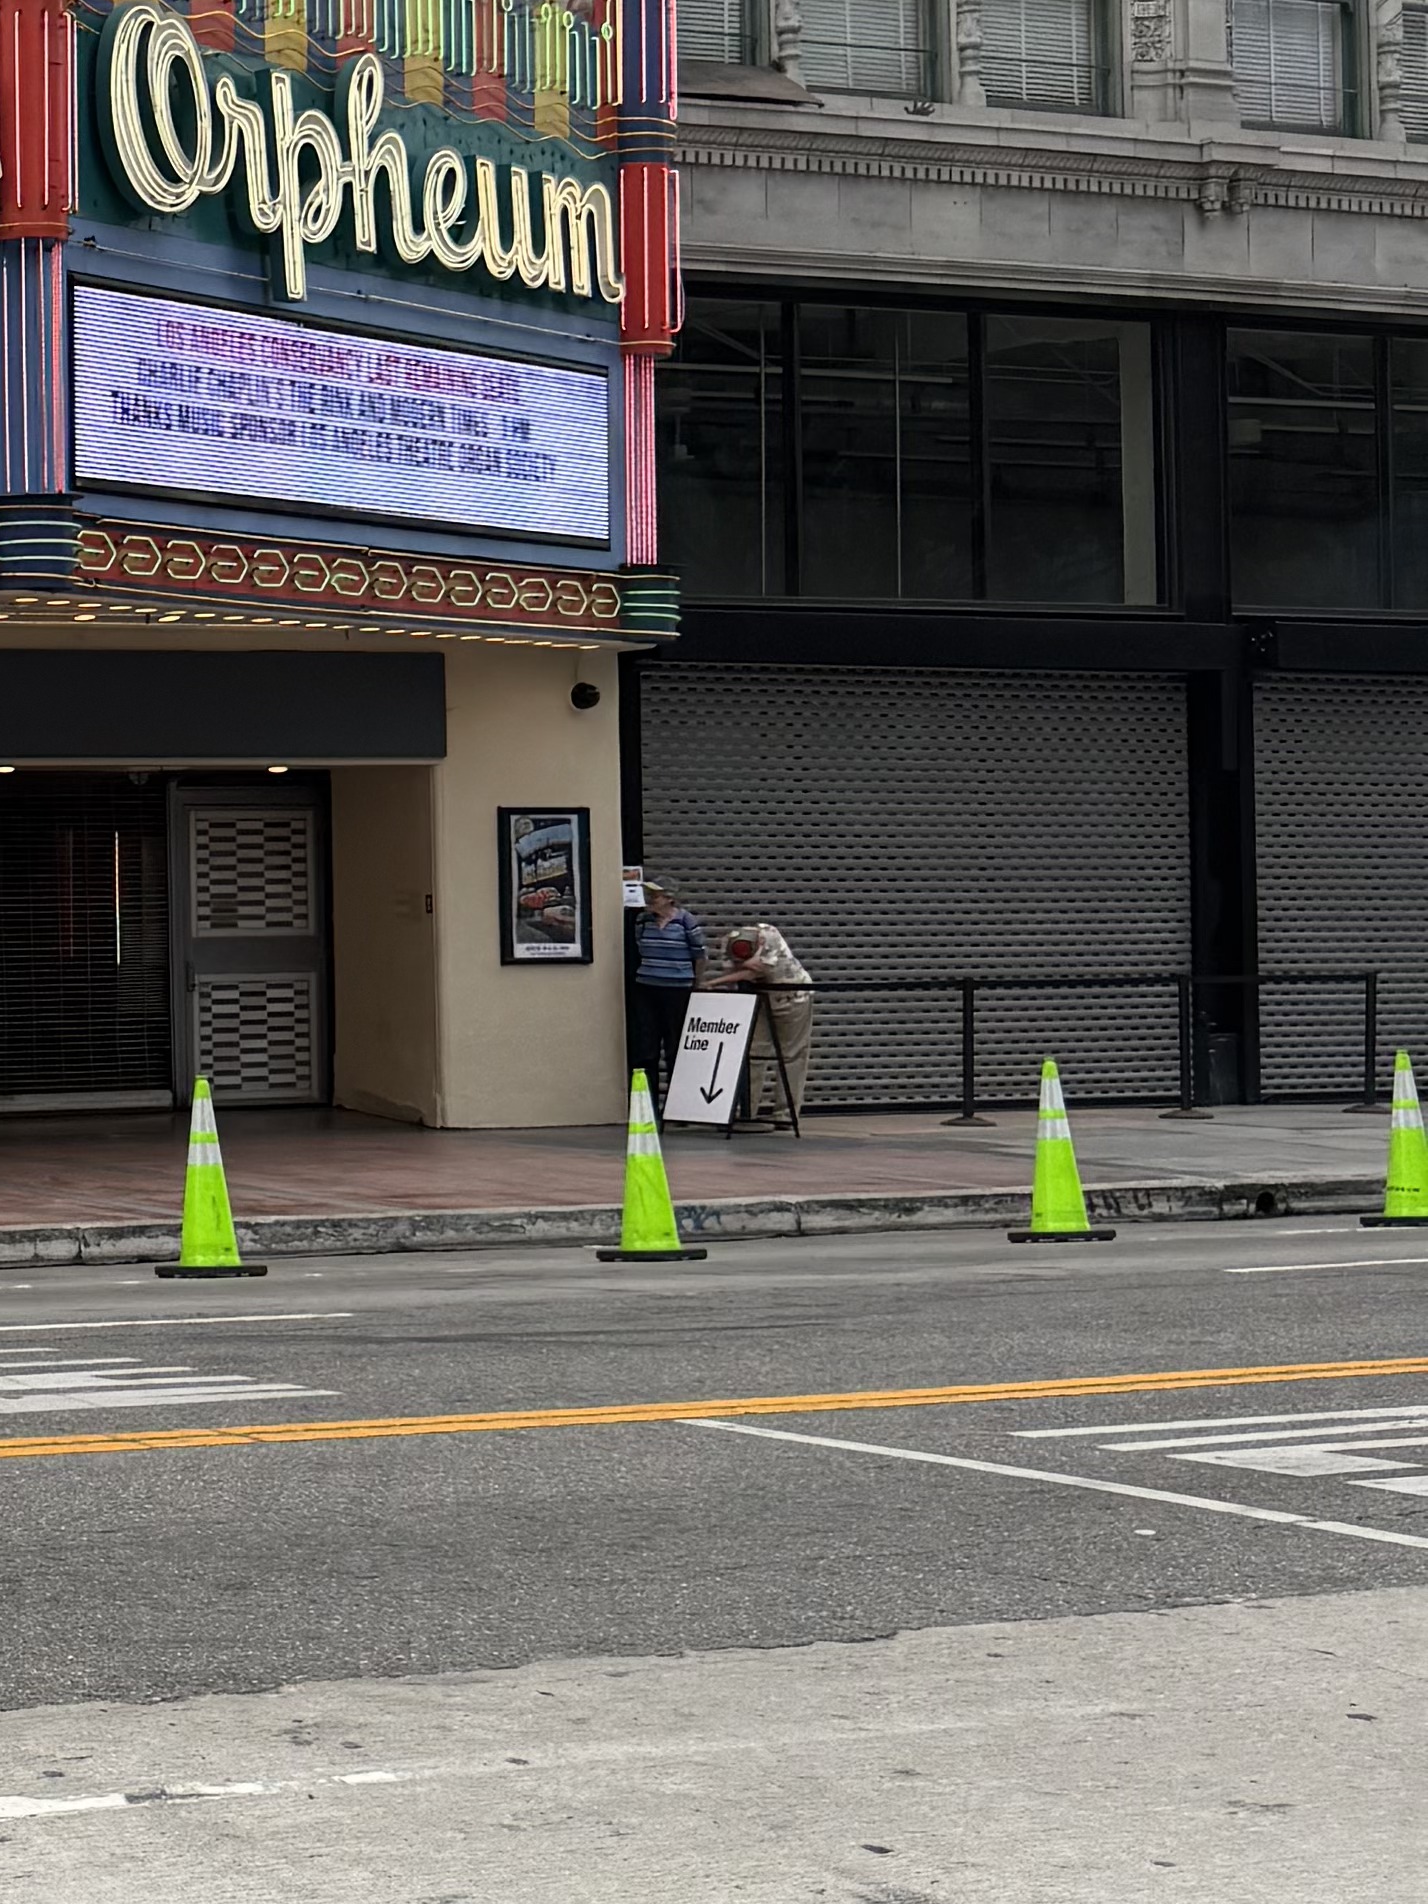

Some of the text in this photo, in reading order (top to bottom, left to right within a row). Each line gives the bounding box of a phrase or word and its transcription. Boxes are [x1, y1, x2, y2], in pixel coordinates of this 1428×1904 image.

[100, 4, 624, 302] Orpheum
[687, 1017, 741, 1035] Member
[683, 1035, 709, 1051] Line
